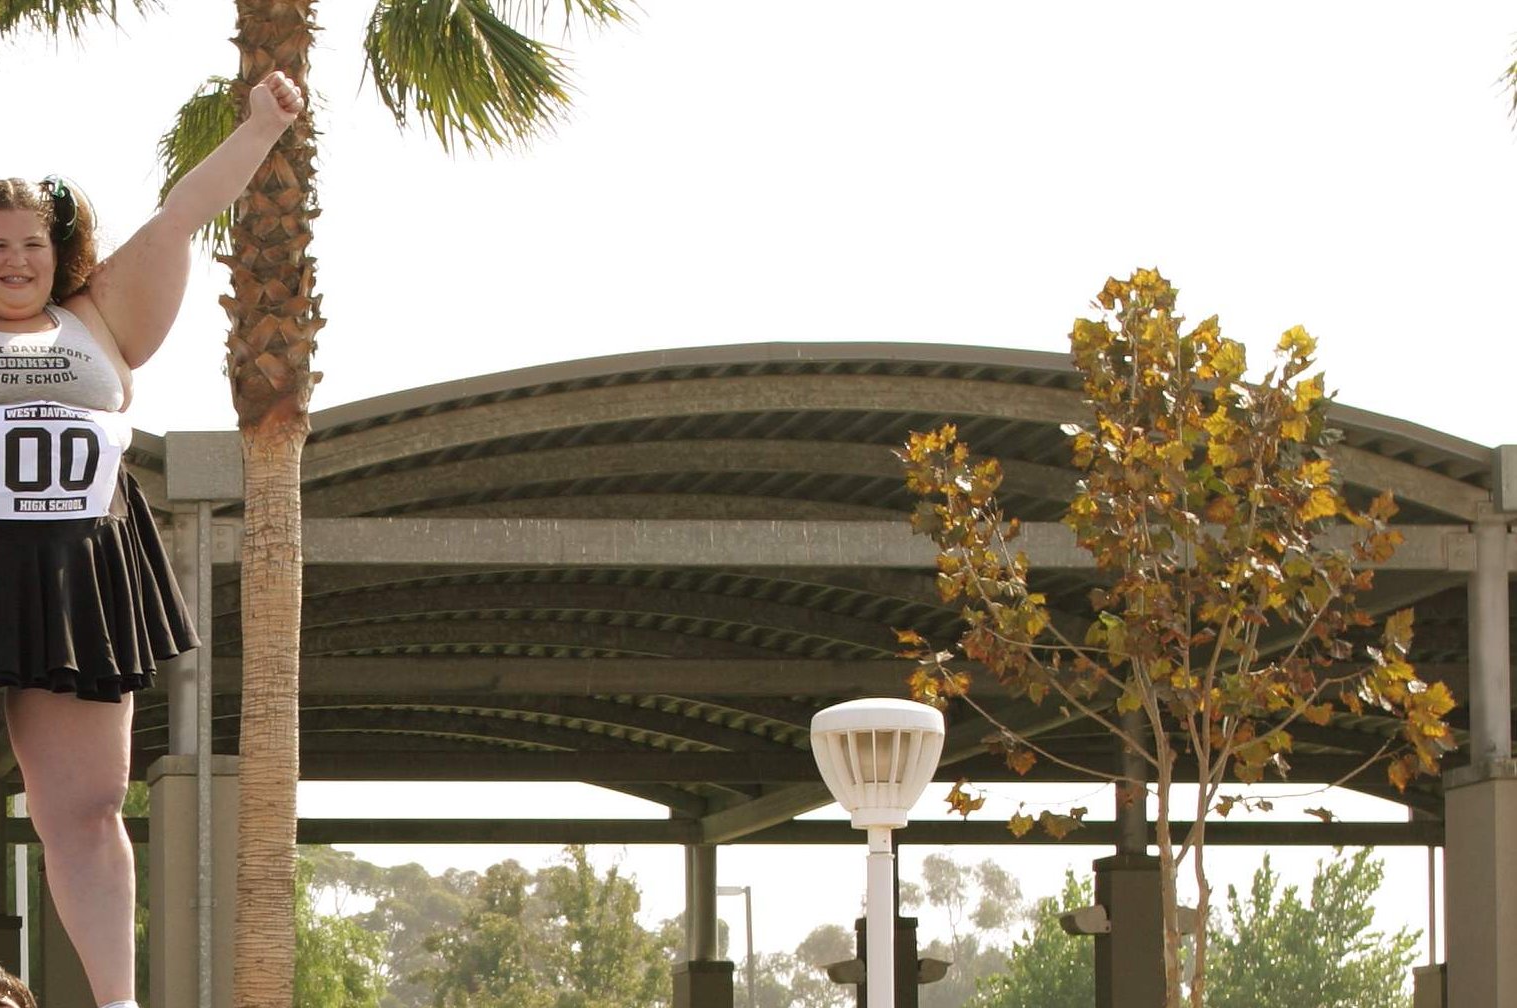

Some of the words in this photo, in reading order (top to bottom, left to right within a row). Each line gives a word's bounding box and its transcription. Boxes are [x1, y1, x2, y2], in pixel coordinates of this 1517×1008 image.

[11, 344, 92, 363] DAVENPORT
[25, 370, 78, 385] SCHOOL
[6, 407, 37, 419] WEST
[5, 427, 100, 492] 00
[19, 500, 46, 511] HIGH
[48, 498, 83, 511] SCHOOL
